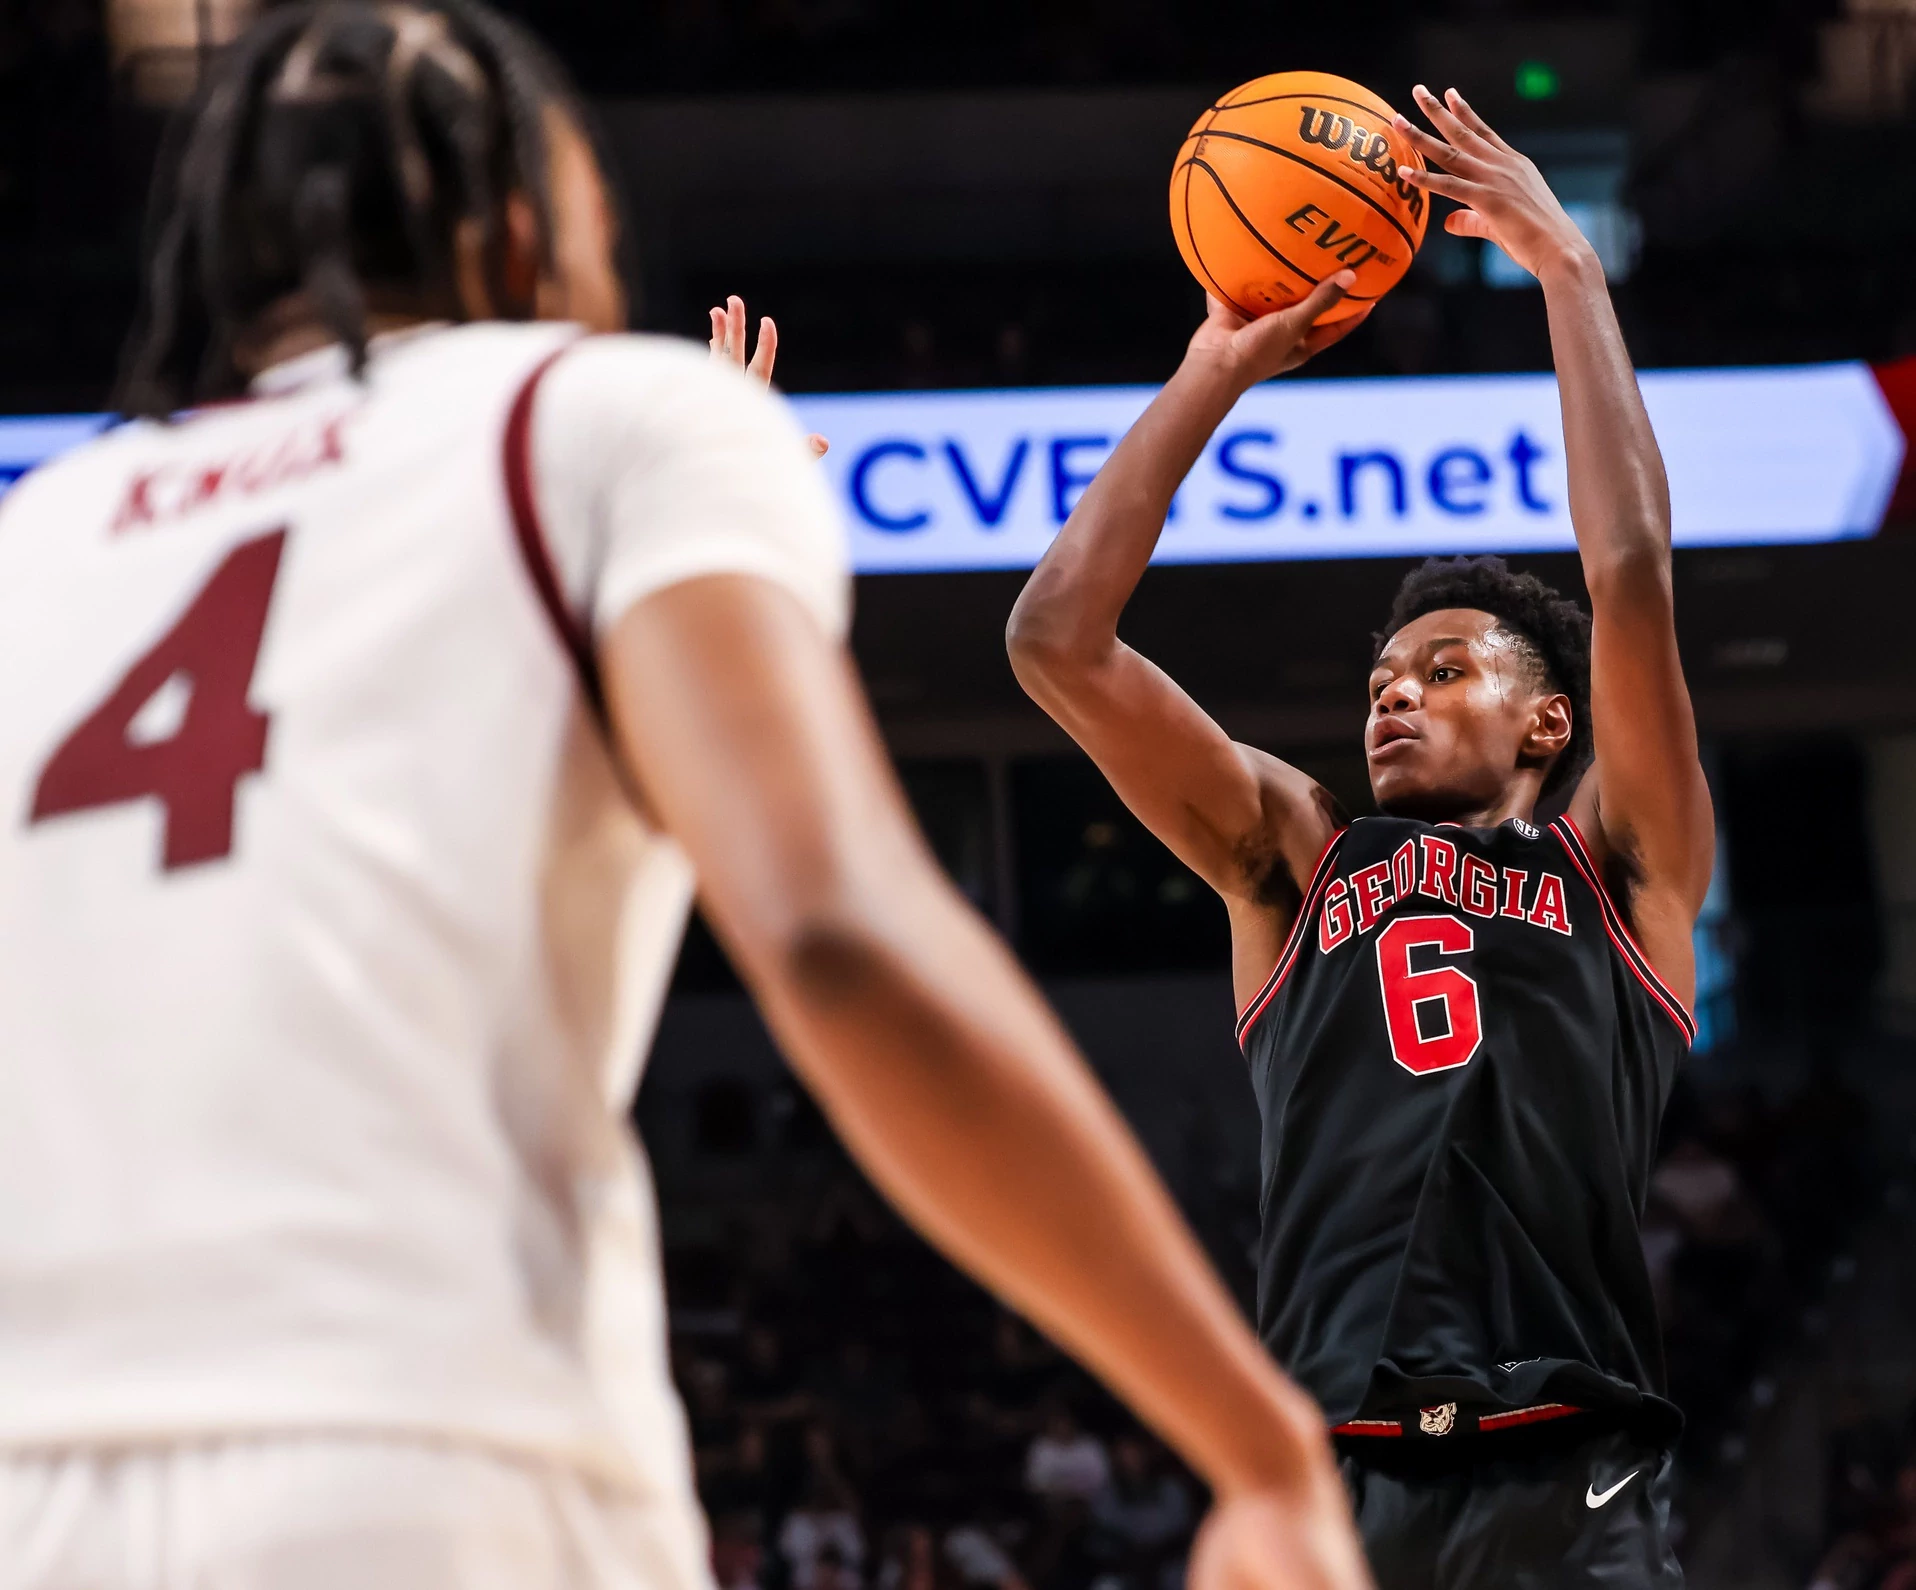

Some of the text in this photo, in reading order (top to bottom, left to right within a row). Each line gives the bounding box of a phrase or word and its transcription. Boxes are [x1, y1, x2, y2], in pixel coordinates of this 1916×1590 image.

[1298, 105, 1424, 230] Wilson
[1284, 203, 1379, 269] EVO
[849, 429, 1553, 533] CVES.net
[27, 523, 290, 873] 4
[1514, 818, 1541, 838] SEC
[1319, 834, 1573, 955] GEORGIA
[1375, 914, 1483, 1077] 6
